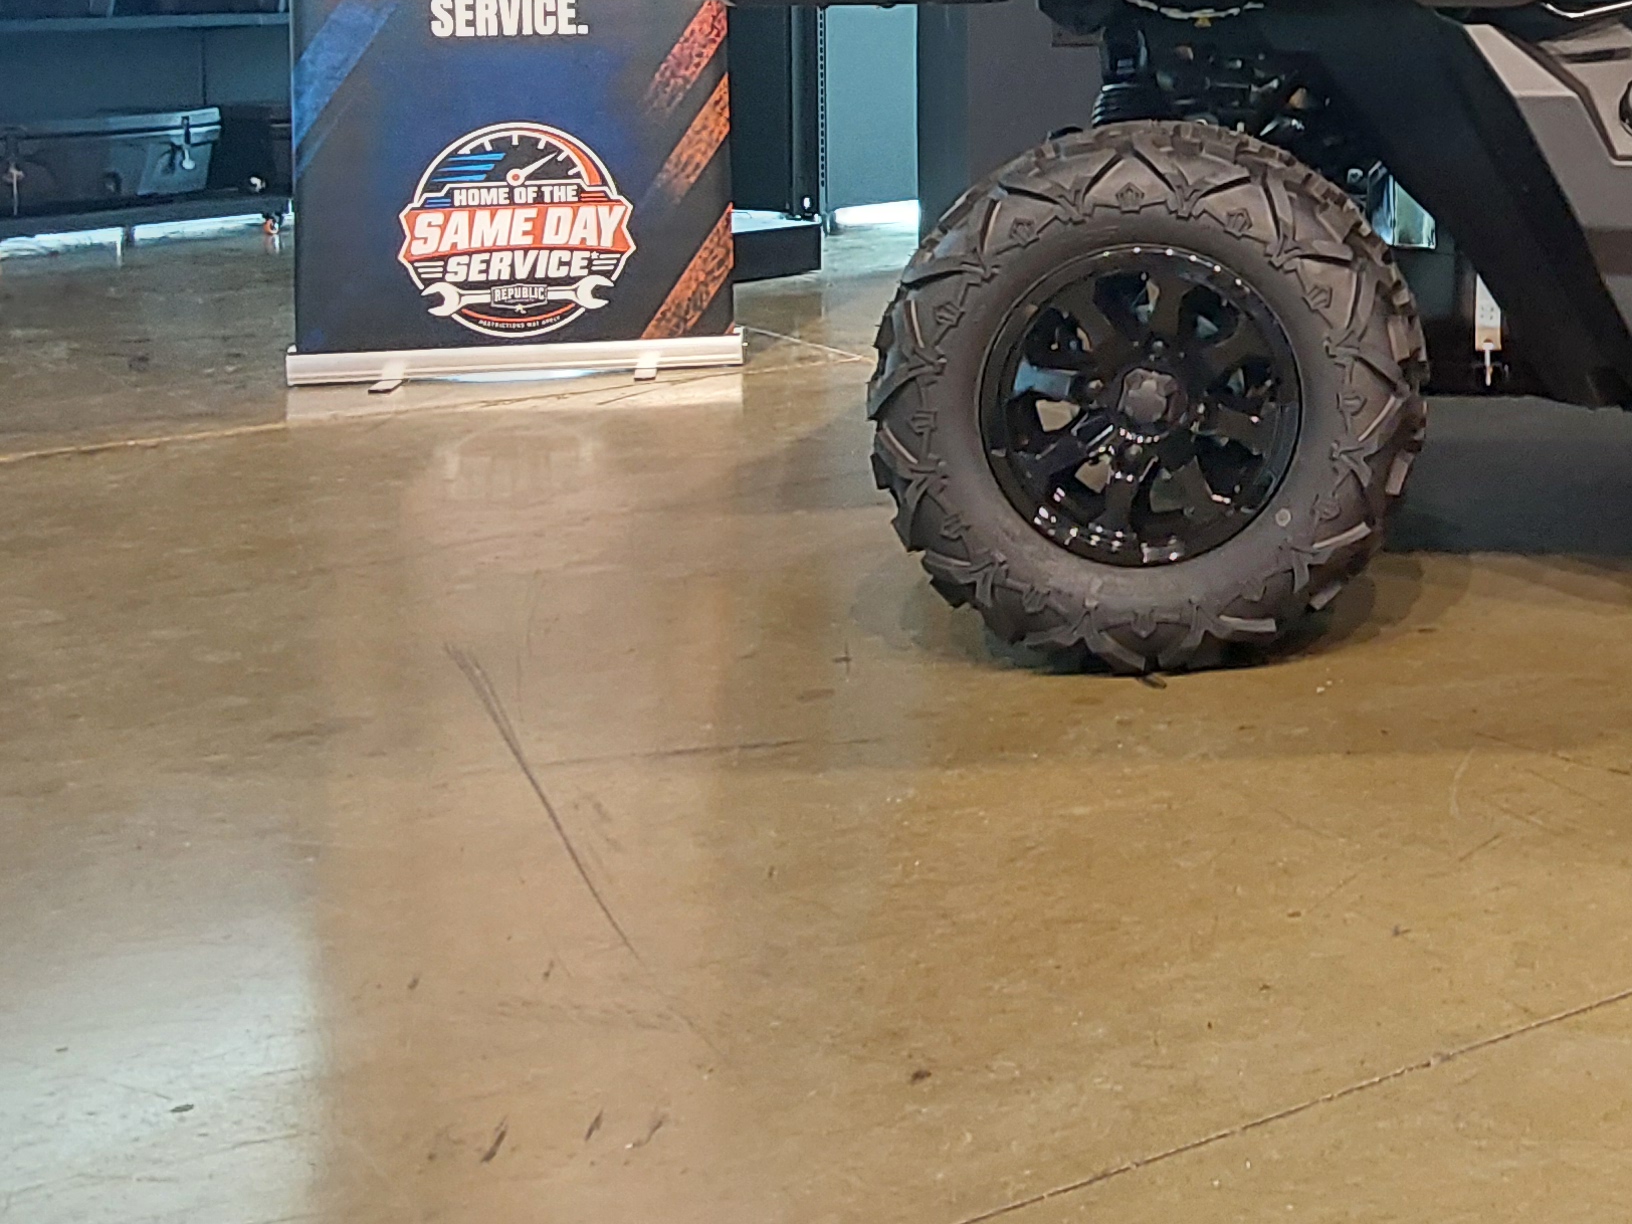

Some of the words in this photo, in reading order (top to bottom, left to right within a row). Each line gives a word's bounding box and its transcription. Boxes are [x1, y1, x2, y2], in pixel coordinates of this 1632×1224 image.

[453, 186, 510, 206] HOME
[514, 186, 538, 204] OF
[541, 185, 579, 203] THE
[410, 207, 538, 256] SAME
[542, 205, 628, 247] DAY
[494, 287, 544, 302] REPUBLIC
